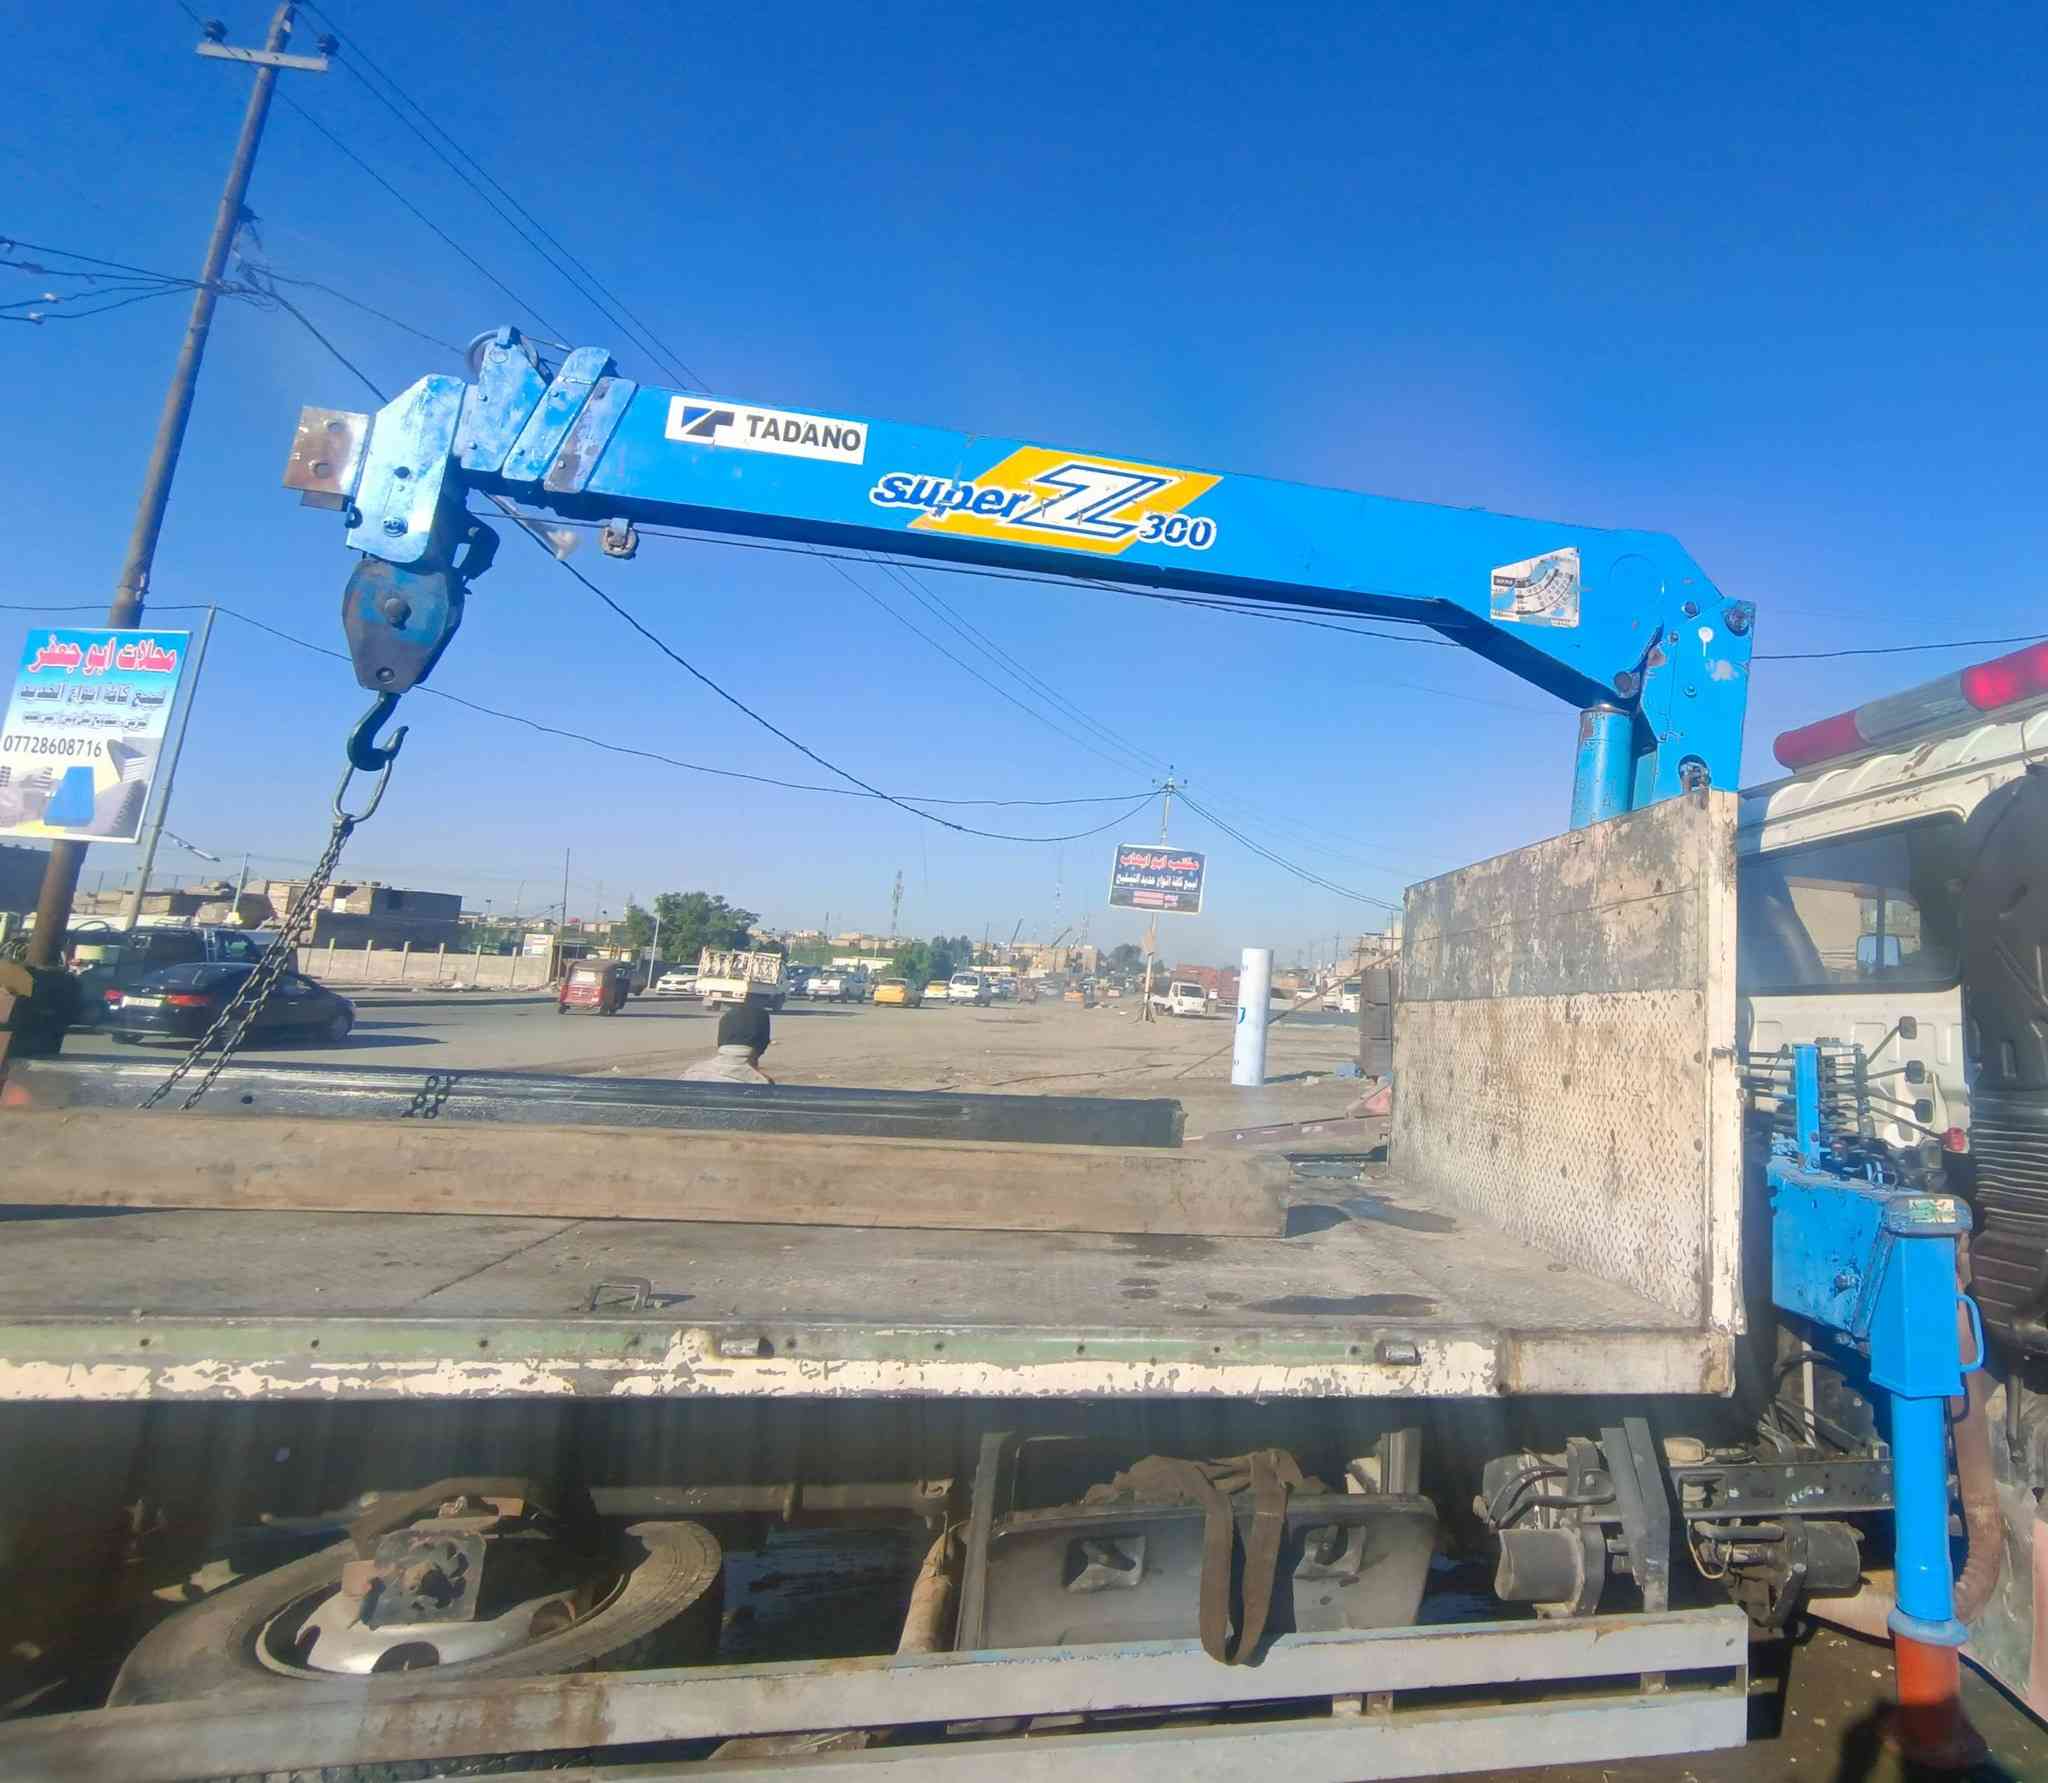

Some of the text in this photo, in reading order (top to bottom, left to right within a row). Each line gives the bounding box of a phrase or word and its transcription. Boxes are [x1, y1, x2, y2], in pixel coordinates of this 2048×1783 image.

[745, 414, 862, 452] TADANO
[873, 474, 1030, 521] super
[1138, 511, 1215, 549] 300
[28, 634, 84, 674] جعفر
[117, 638, 177, 673] محلات
[3, 735, 103, 758] 07728608716
